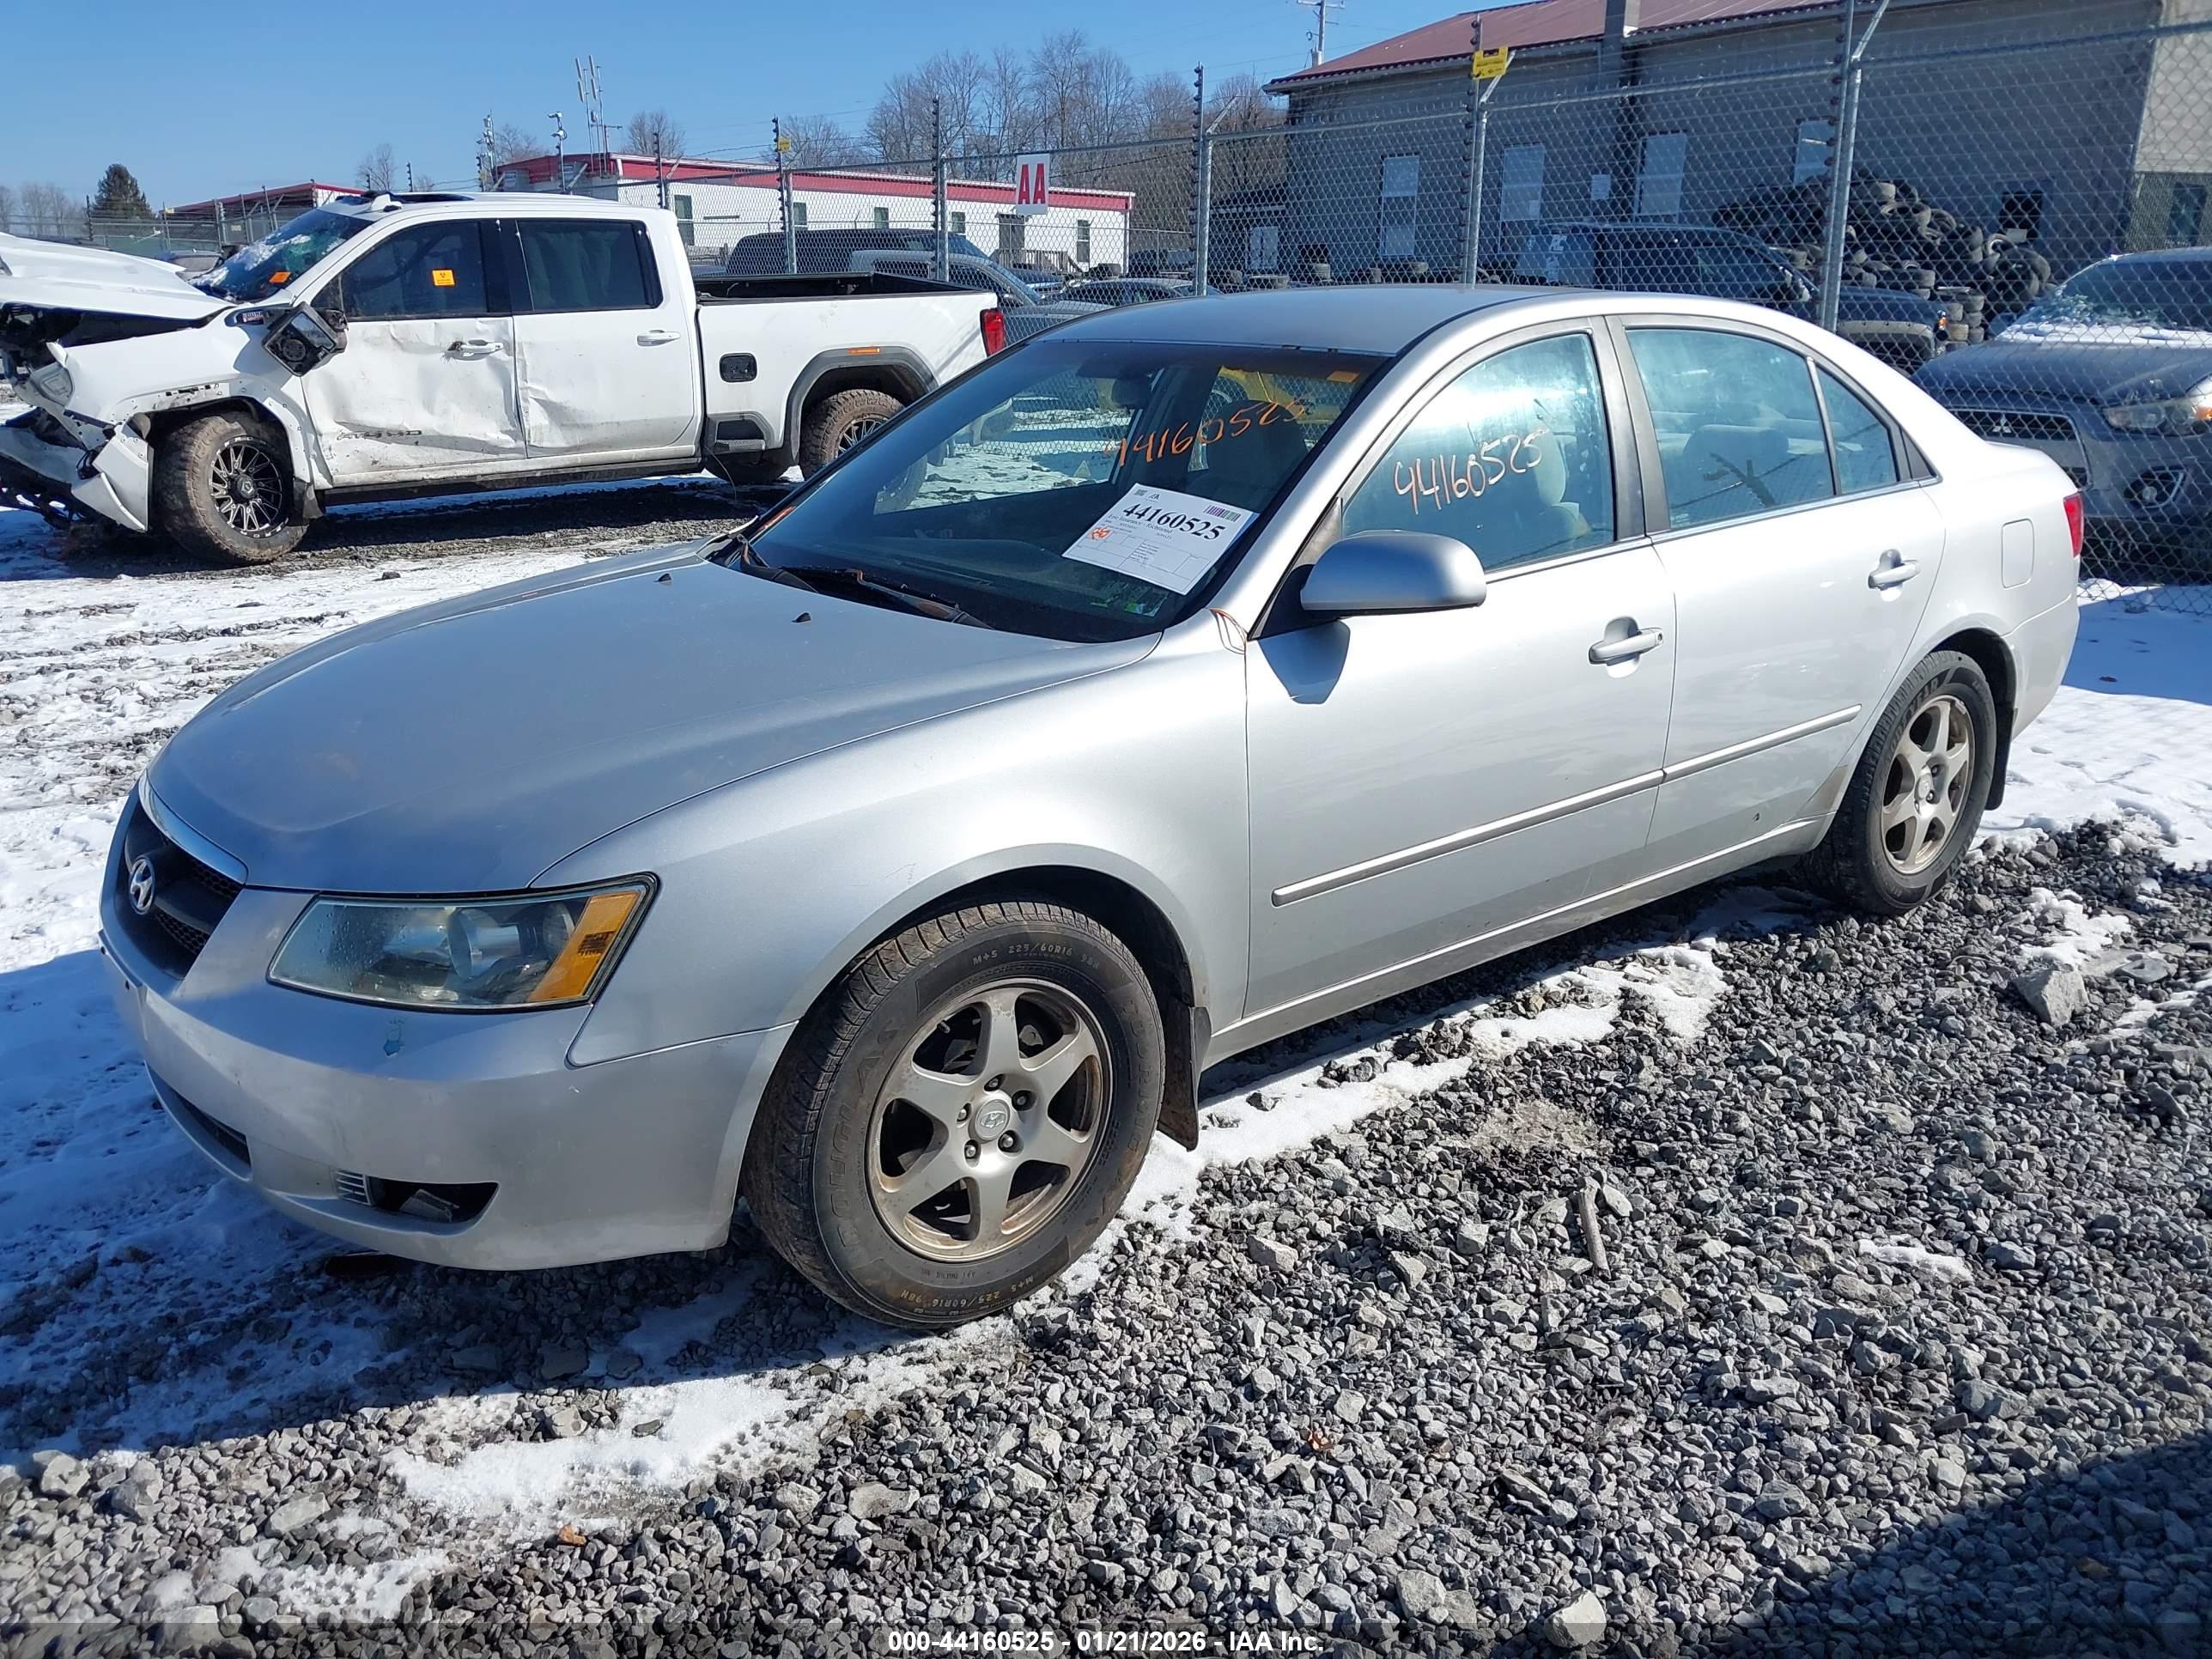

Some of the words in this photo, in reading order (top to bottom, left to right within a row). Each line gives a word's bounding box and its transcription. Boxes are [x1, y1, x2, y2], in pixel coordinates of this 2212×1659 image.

[1018, 163, 1046, 204] AA
[1395, 429, 1550, 515] 44160525
[1123, 503, 1226, 540] 44160525
[973, 950, 998, 965] M+S
[1008, 943, 1073, 956] 225/60R16
[932, 1290, 1001, 1308] 225/60R16
